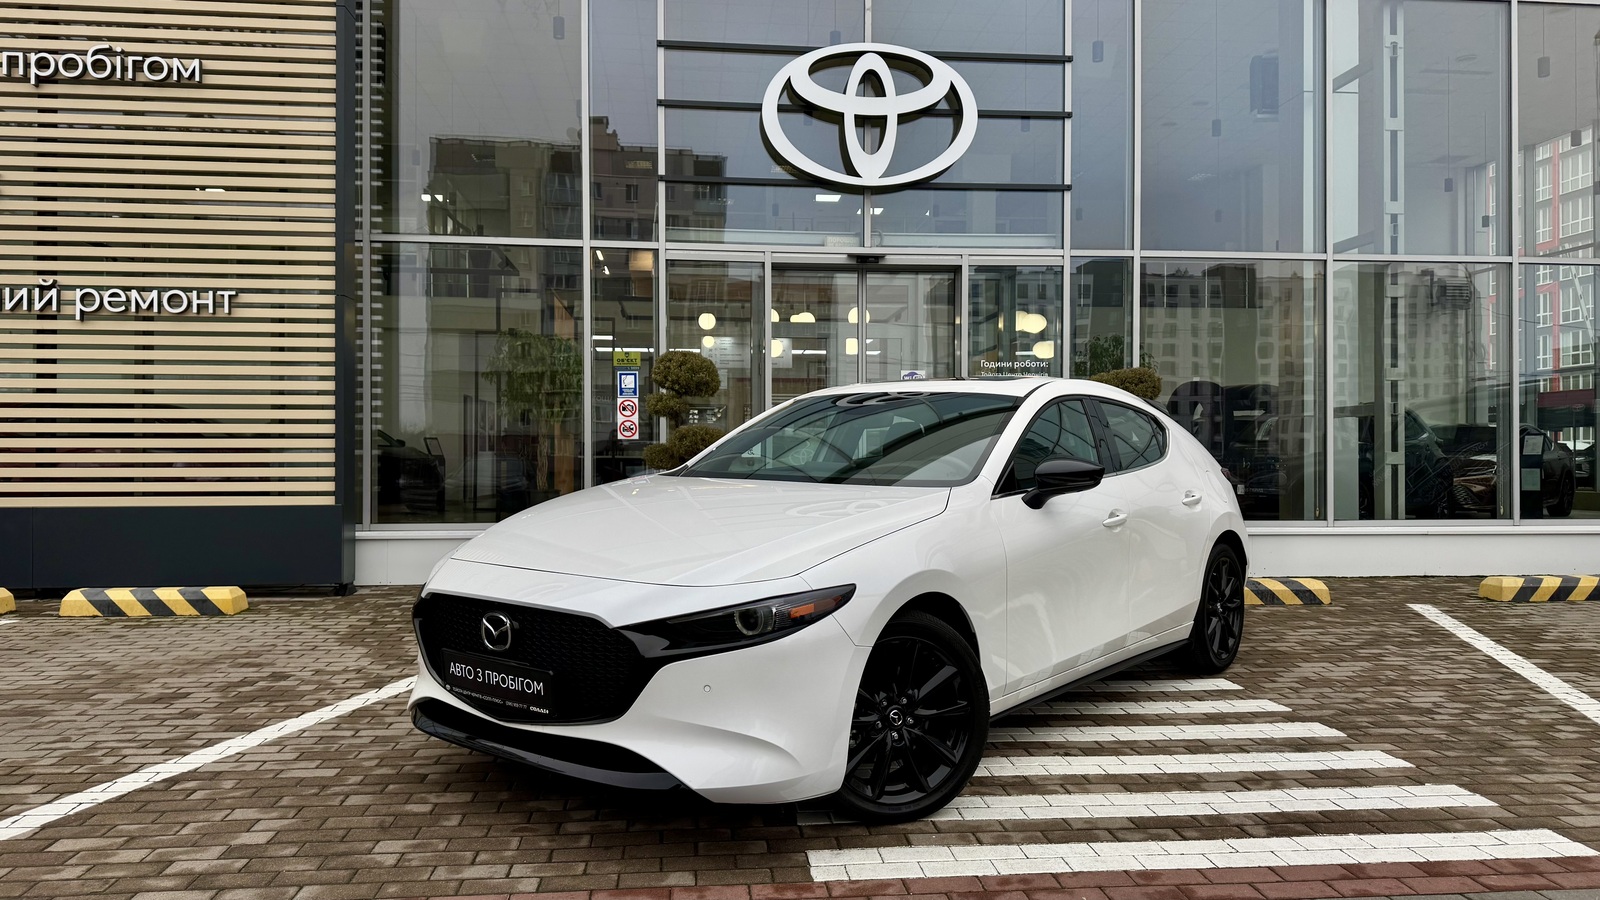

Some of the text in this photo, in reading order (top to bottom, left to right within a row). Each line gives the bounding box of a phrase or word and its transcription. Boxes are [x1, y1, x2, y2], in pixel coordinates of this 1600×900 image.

[2, 44, 202, 85] пробігом
[75, 287, 238, 322] ремонт
[980, 359, 1049, 369] Години роботи:
[449, 662, 474, 679] АВТО
[485, 670, 544, 696] ПРОБІГОМ
